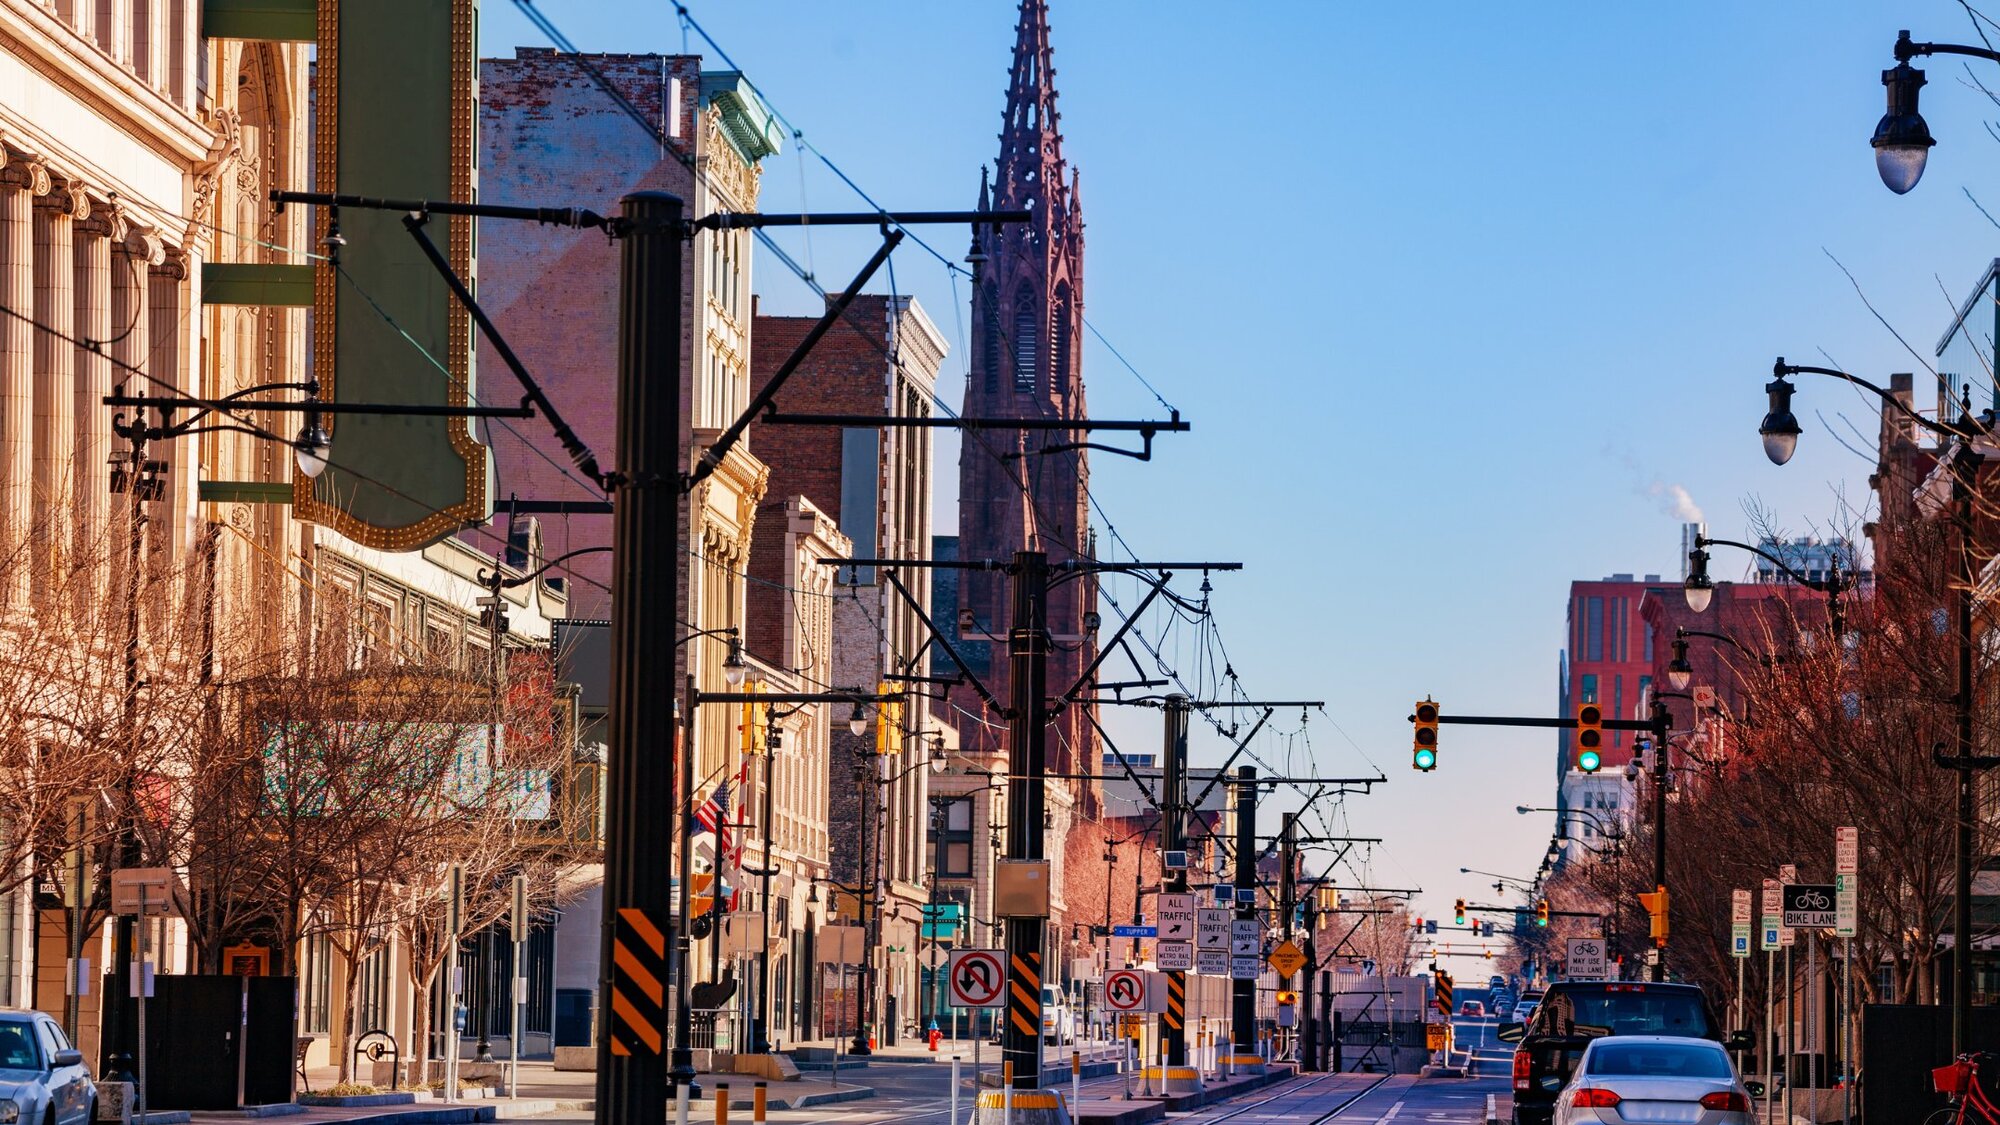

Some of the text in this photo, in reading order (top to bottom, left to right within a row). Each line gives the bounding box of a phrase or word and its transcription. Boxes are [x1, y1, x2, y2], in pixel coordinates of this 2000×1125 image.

[1837, 878, 1842, 890] 2
[1168, 899, 1183, 908] ALL
[1160, 912, 1191, 920] TRAFFIC
[1207, 913, 1220, 921] ALL
[1786, 913, 1808, 924] BIKE
[1812, 913, 1836, 924] LANE
[1200, 924, 1228, 932] TRAFFIC
